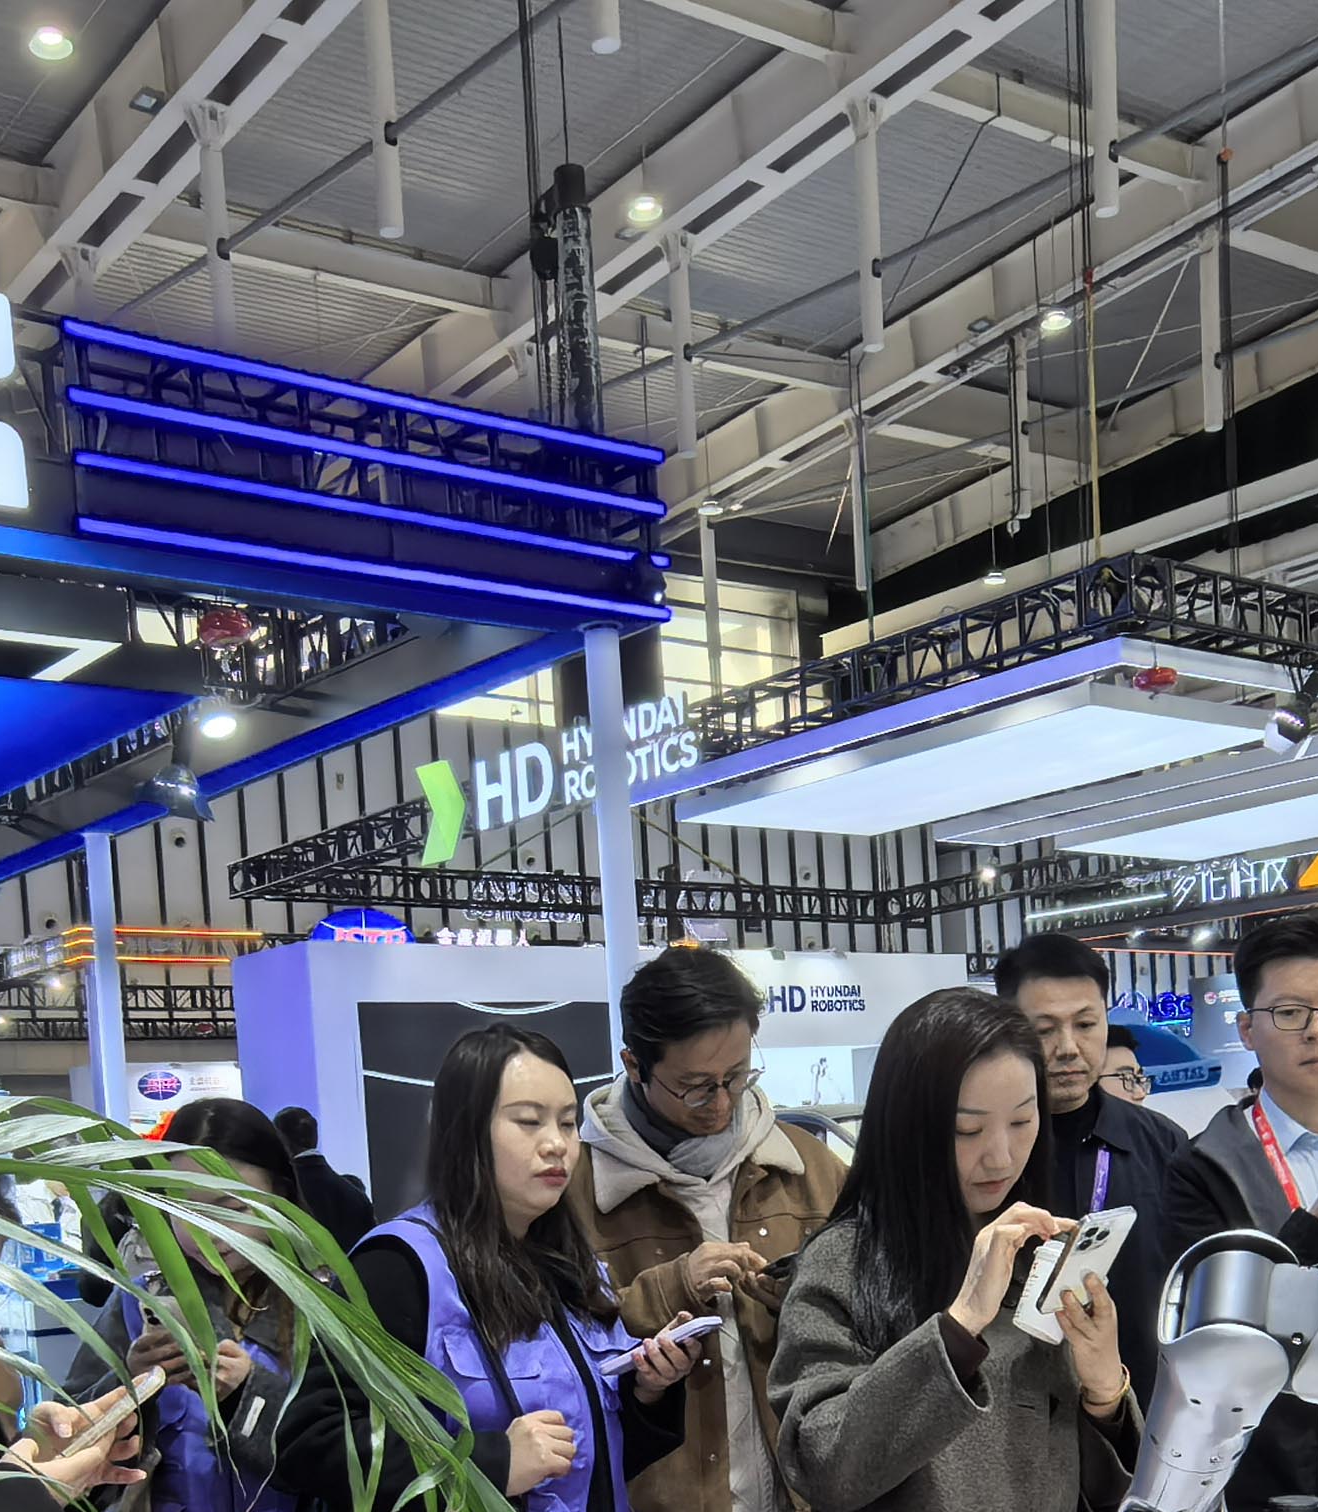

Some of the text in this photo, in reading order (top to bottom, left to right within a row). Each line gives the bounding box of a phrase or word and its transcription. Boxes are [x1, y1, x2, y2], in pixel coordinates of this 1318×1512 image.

[562, 693, 685, 765] HYNDAI
[475, 741, 554, 831] HD
[564, 729, 698, 805] ROTICS
[810, 985, 861, 998] HYUNDAI
[811, 999, 865, 1012] ROBOTICS
